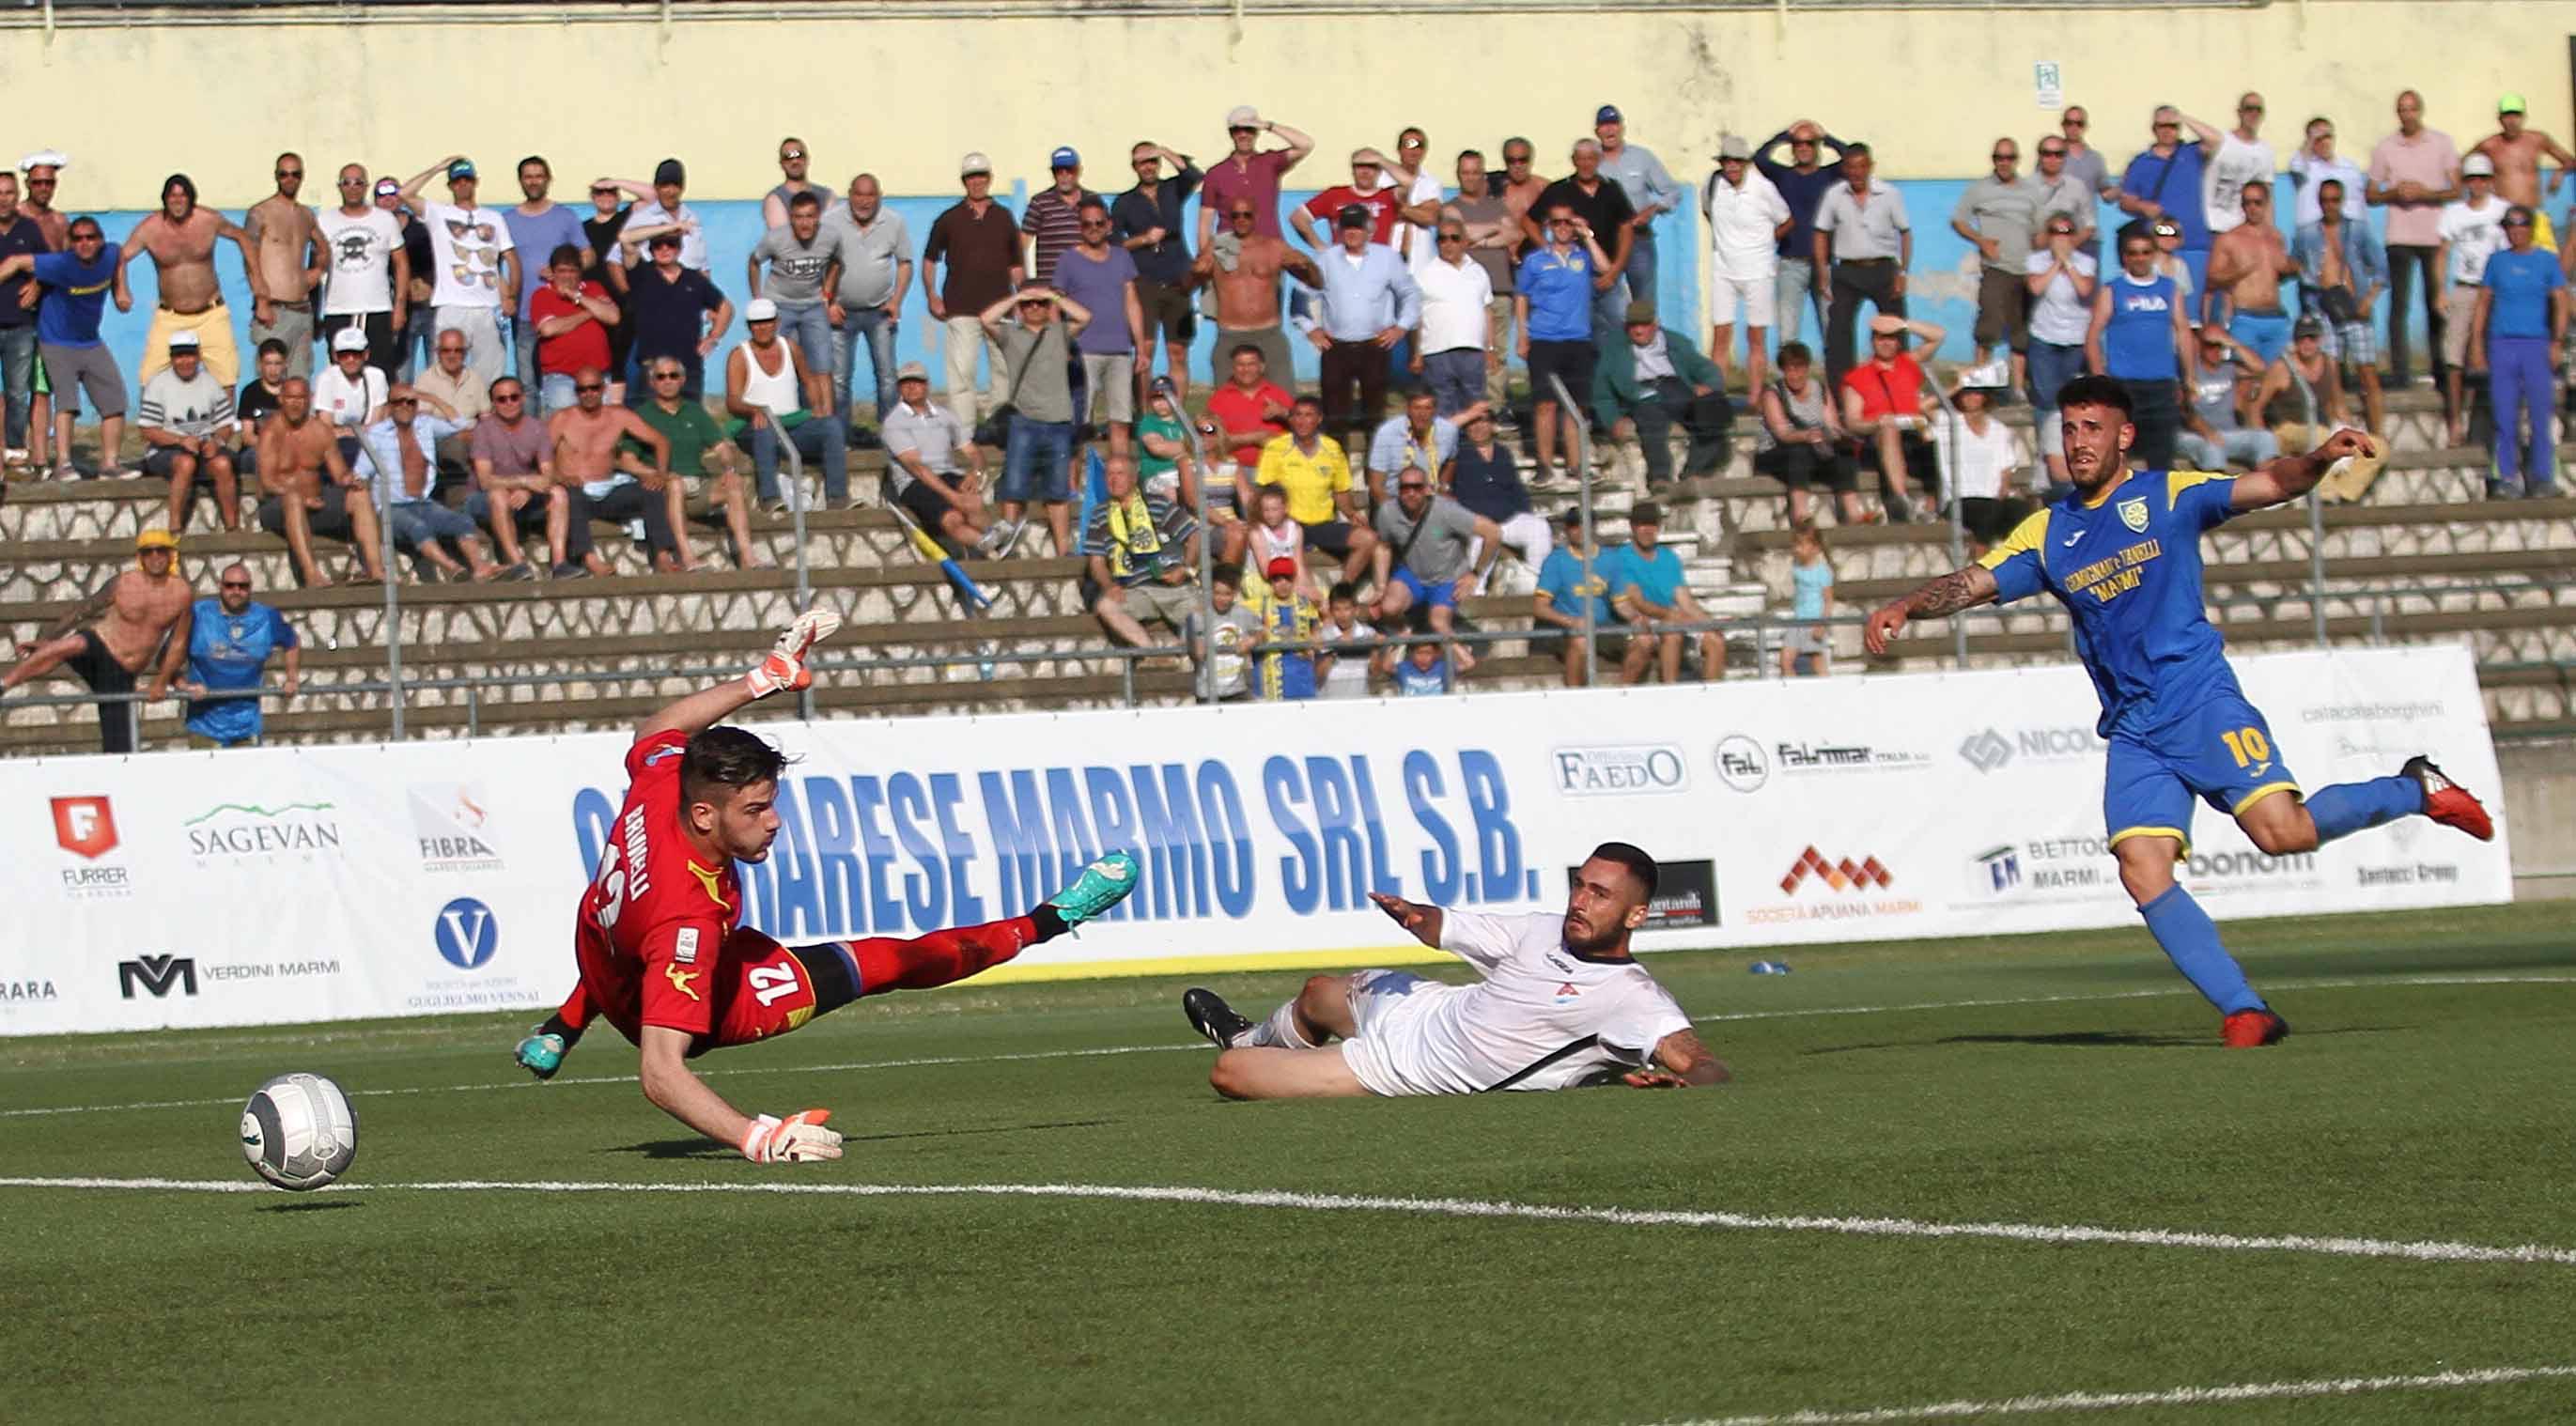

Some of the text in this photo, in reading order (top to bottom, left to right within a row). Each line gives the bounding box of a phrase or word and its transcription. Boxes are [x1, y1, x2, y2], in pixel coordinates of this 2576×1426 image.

[2126, 294, 2167, 312] FILA
[2019, 727, 2109, 755] NICOL
[2221, 727, 2270, 767] 10
[190, 822, 340, 855] SAGEVAN
[420, 836, 496, 859] FIBRA
[978, 760, 1255, 921] MARMO
[1263, 754, 1403, 915] SRL
[1403, 749, 1542, 907] S.B.
[62, 867, 128, 885] FURRER
[2033, 869, 2101, 890] MARMI
[203, 960, 341, 981] VERDINI MARMI
[749, 961, 799, 1007] 12
